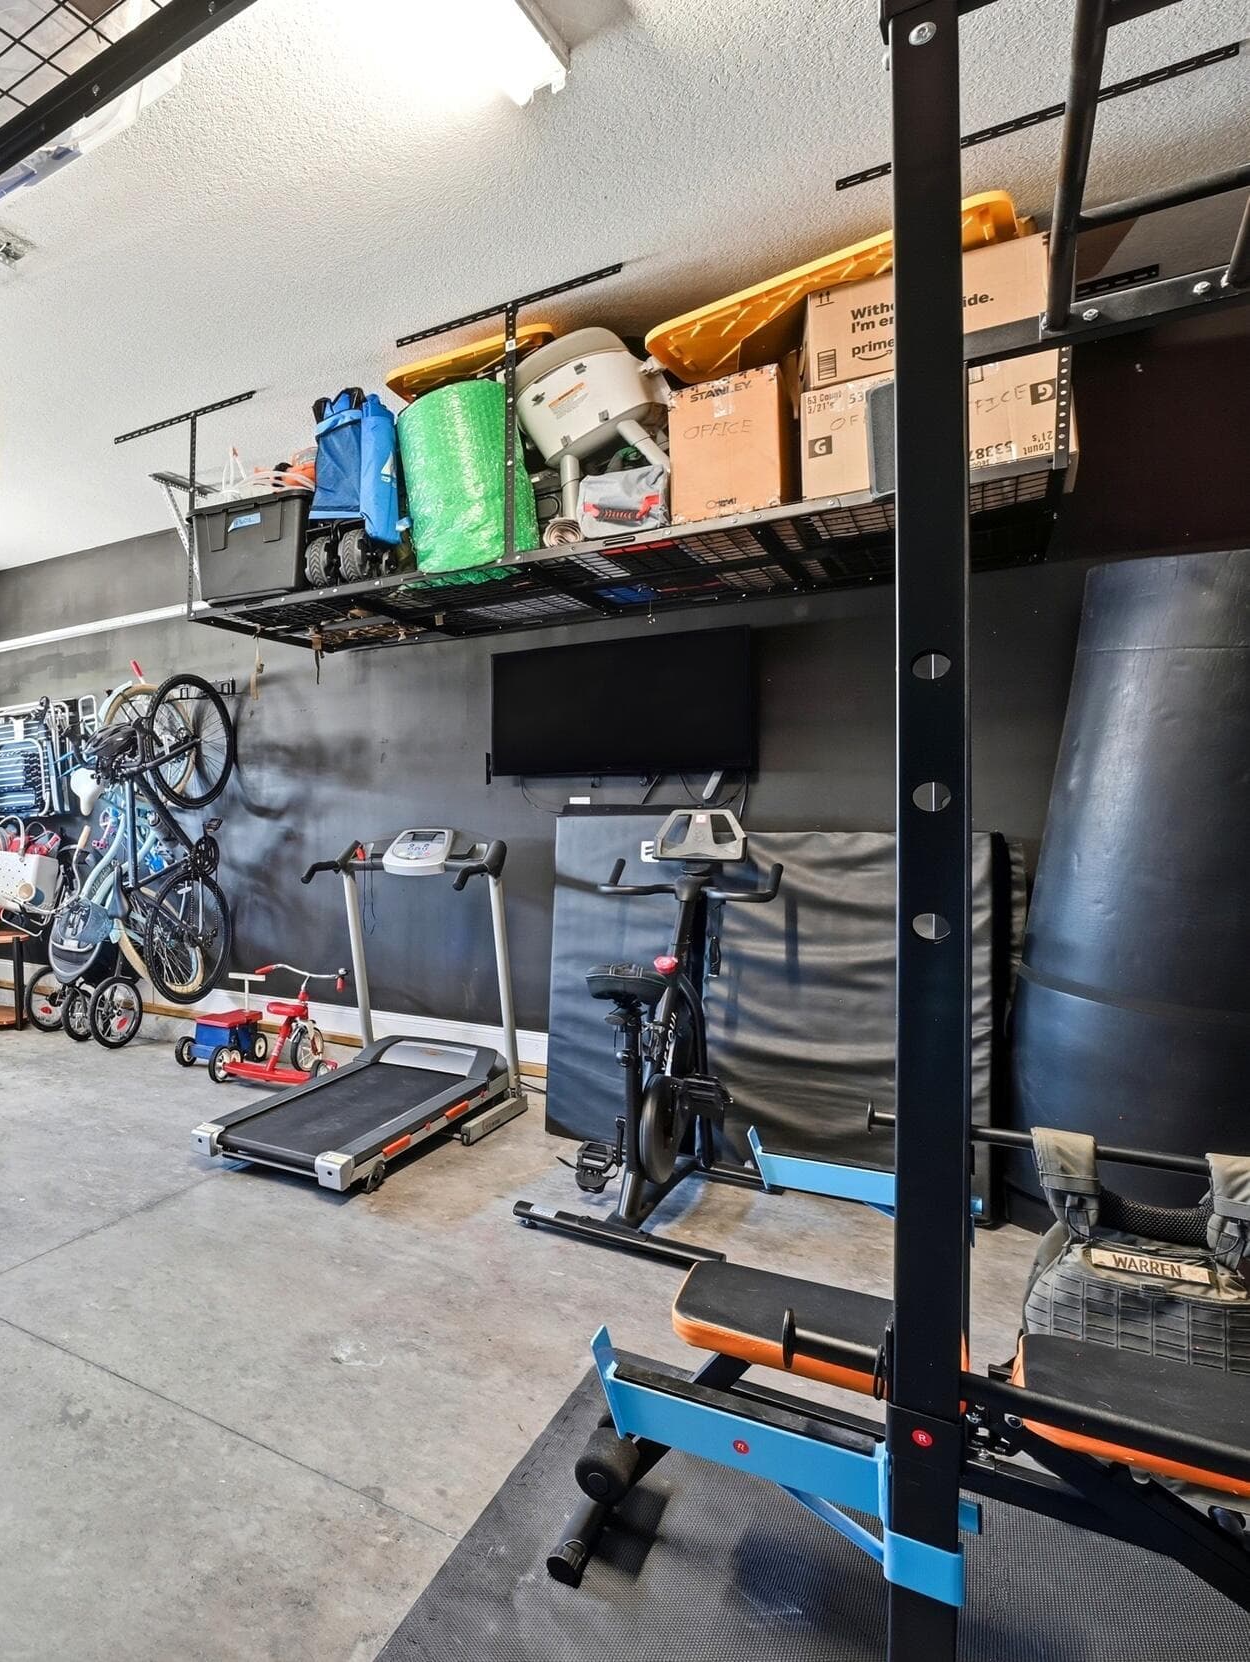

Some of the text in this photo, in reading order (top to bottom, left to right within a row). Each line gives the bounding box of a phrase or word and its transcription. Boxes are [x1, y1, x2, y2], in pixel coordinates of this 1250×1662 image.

[963, 293, 995, 308] ide.
[851, 322, 875, 334] I'm
[852, 338, 894, 358] prime
[690, 380, 751, 403] STANLEY
[849, 391, 864, 404] 53
[974, 383, 1028, 415] FICE
[683, 420, 752, 440] OFFICE
[830, 415, 860, 431] OF
[1031, 430, 1054, 442] 21's
[1023, 442, 1051, 455] Count
[1112, 1254, 1183, 1278] WARREN
